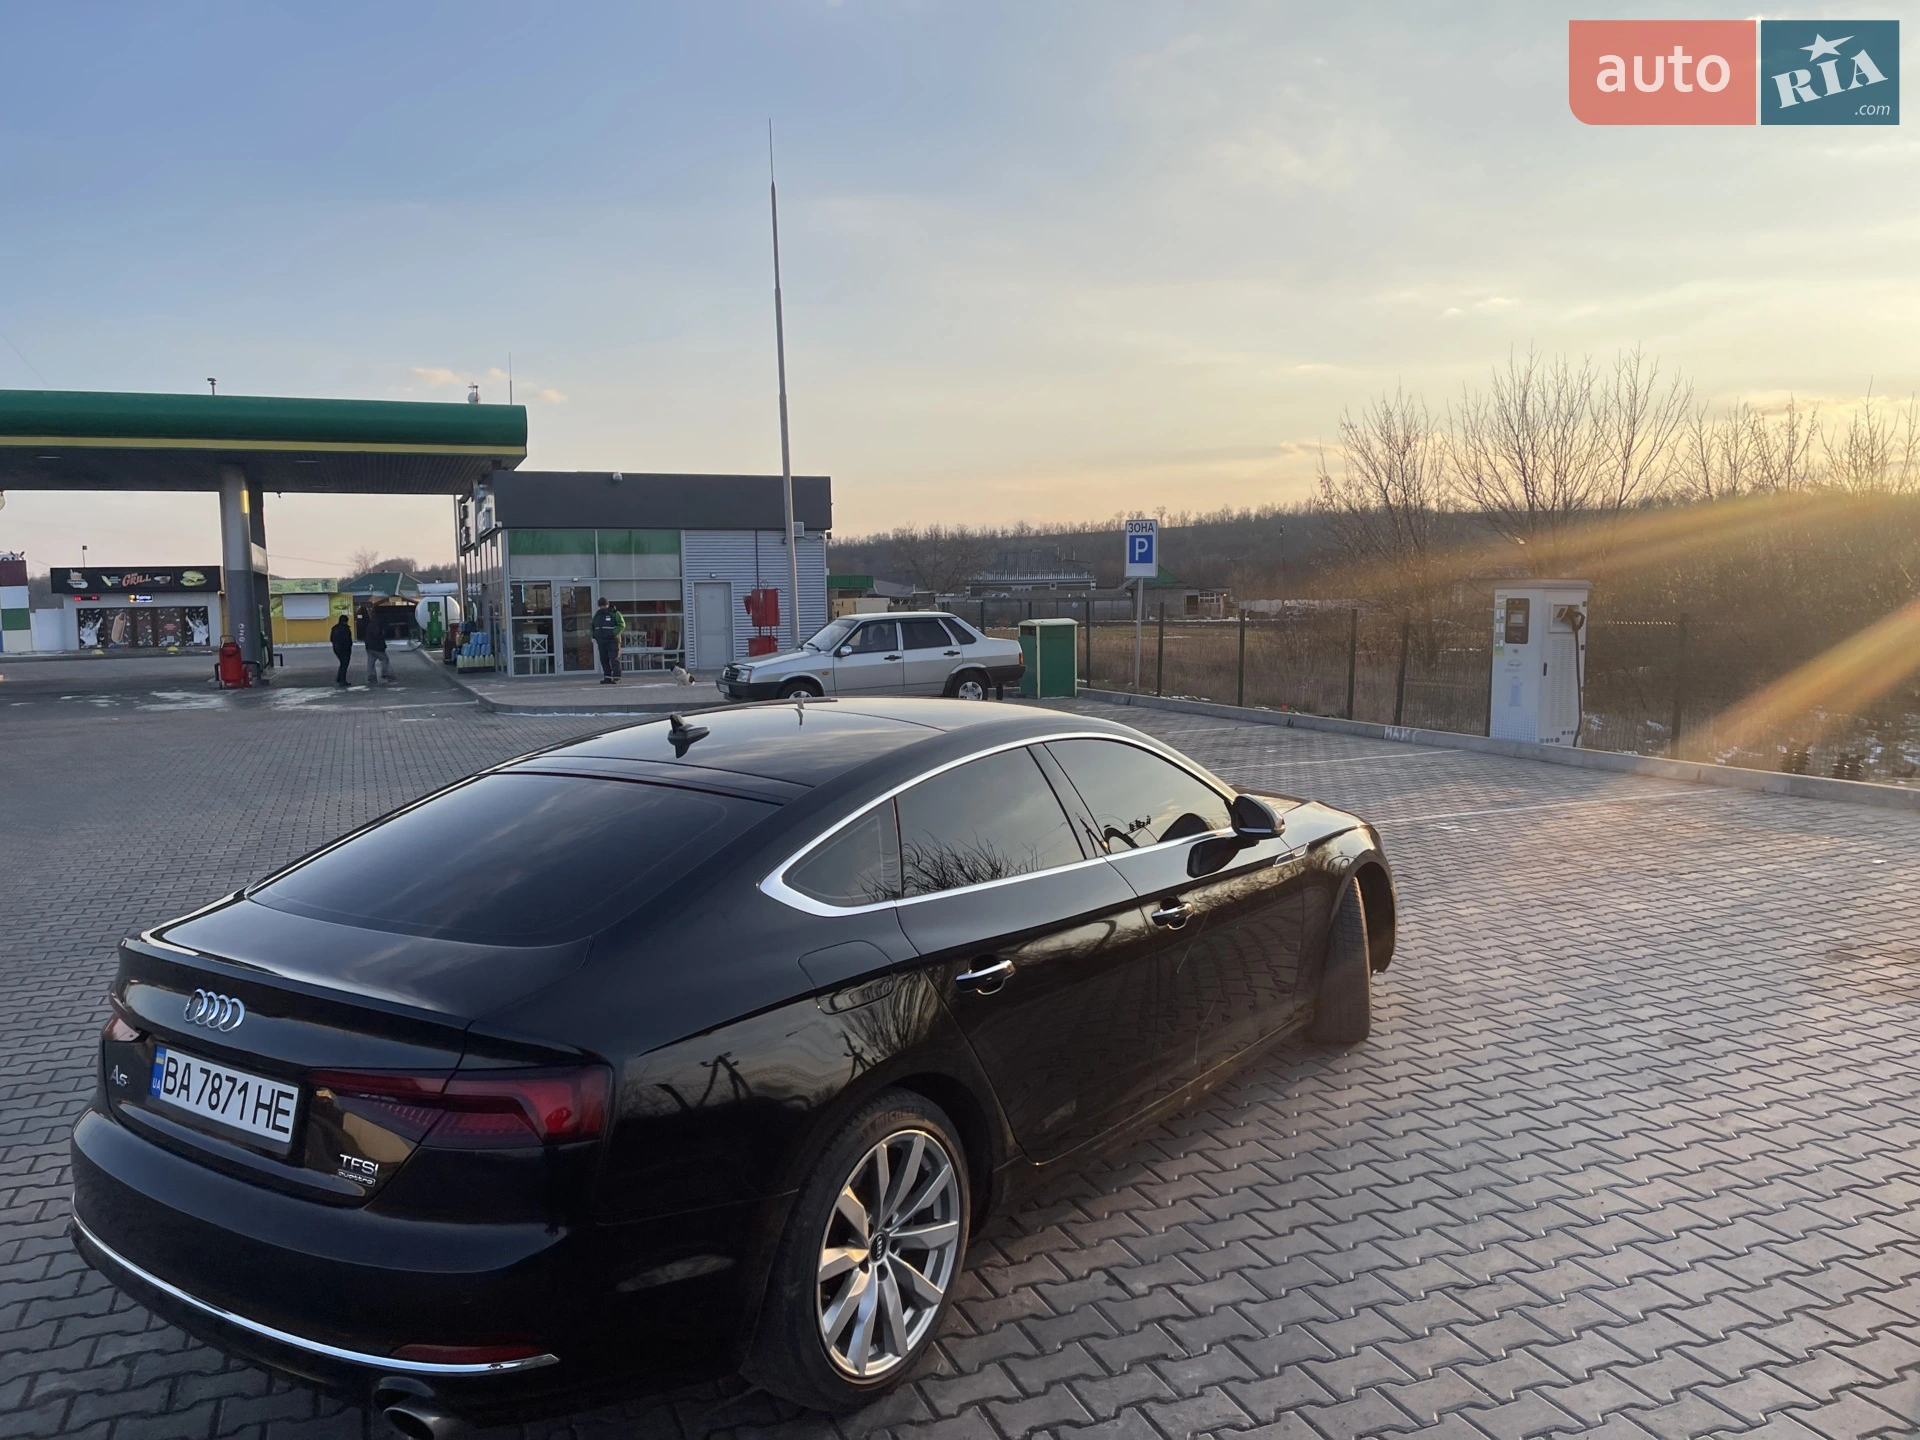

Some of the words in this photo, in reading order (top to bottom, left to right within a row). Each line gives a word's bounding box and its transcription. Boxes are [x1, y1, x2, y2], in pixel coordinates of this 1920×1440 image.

[1128, 522, 1154, 533] ЗОНА
[1135, 537, 1149, 561] P
[122, 573, 151, 587] GRILL
[110, 1064, 128, 1087] A5
[152, 1077, 161, 1090] UA
[163, 1056, 190, 1103] BA
[195, 1069, 249, 1121] 7871
[252, 1084, 294, 1134] HE
[340, 1154, 379, 1177] TFSI
